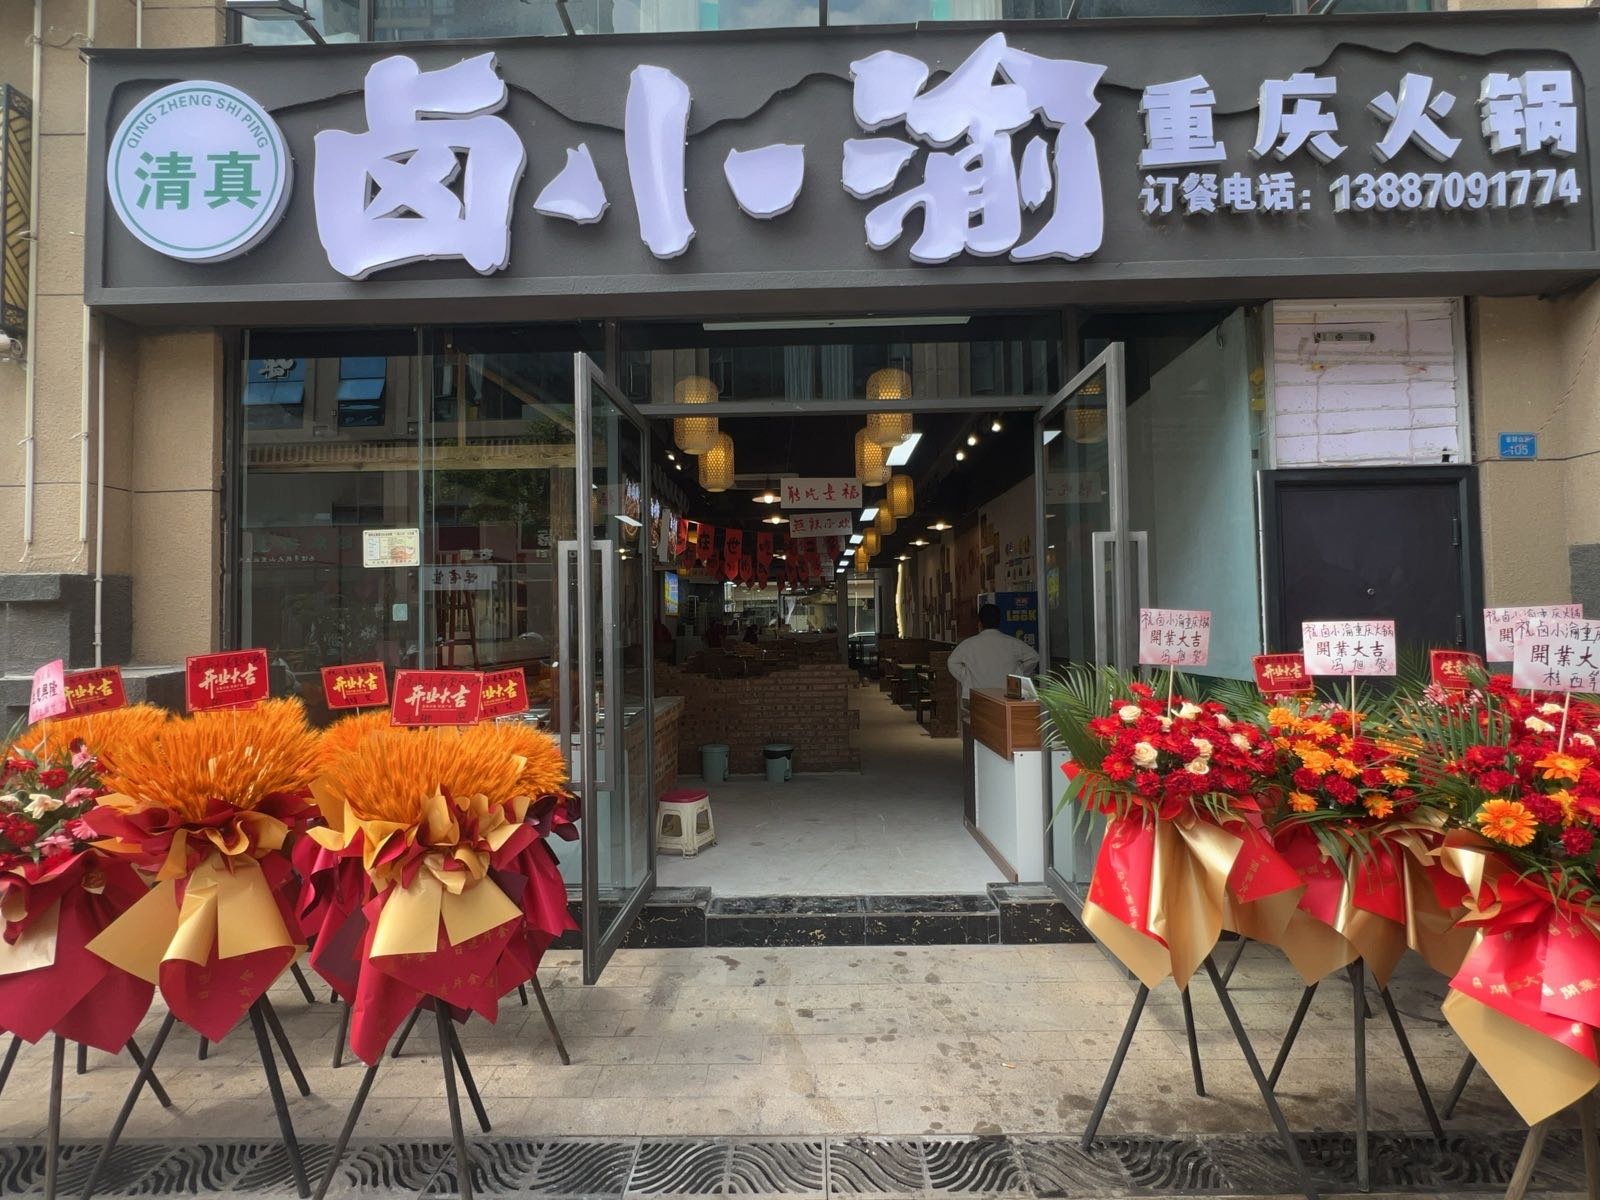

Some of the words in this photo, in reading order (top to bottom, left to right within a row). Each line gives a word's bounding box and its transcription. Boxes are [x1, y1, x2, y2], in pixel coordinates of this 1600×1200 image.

[127, 112, 158, 149] QING
[158, 94, 212, 116] ZHENG
[216, 96, 243, 118] SHI
[242, 113, 269, 149] PING
[1139, 69, 1578, 169] 重庆火锅
[313, 32, 1107, 279] 卤小渝
[134, 150, 262, 211] 清真
[1331, 168, 1582, 216] 13887091774
[1316, 641, 1385, 658] 開業大吉
[198, 662, 258, 699] 开业大吉
[333, 672, 378, 699] 开业大吉
[1262, 662, 1302, 686] 开业大吉
[404, 684, 471, 716] 开业大吉
[482, 679, 518, 710] 业大吉
